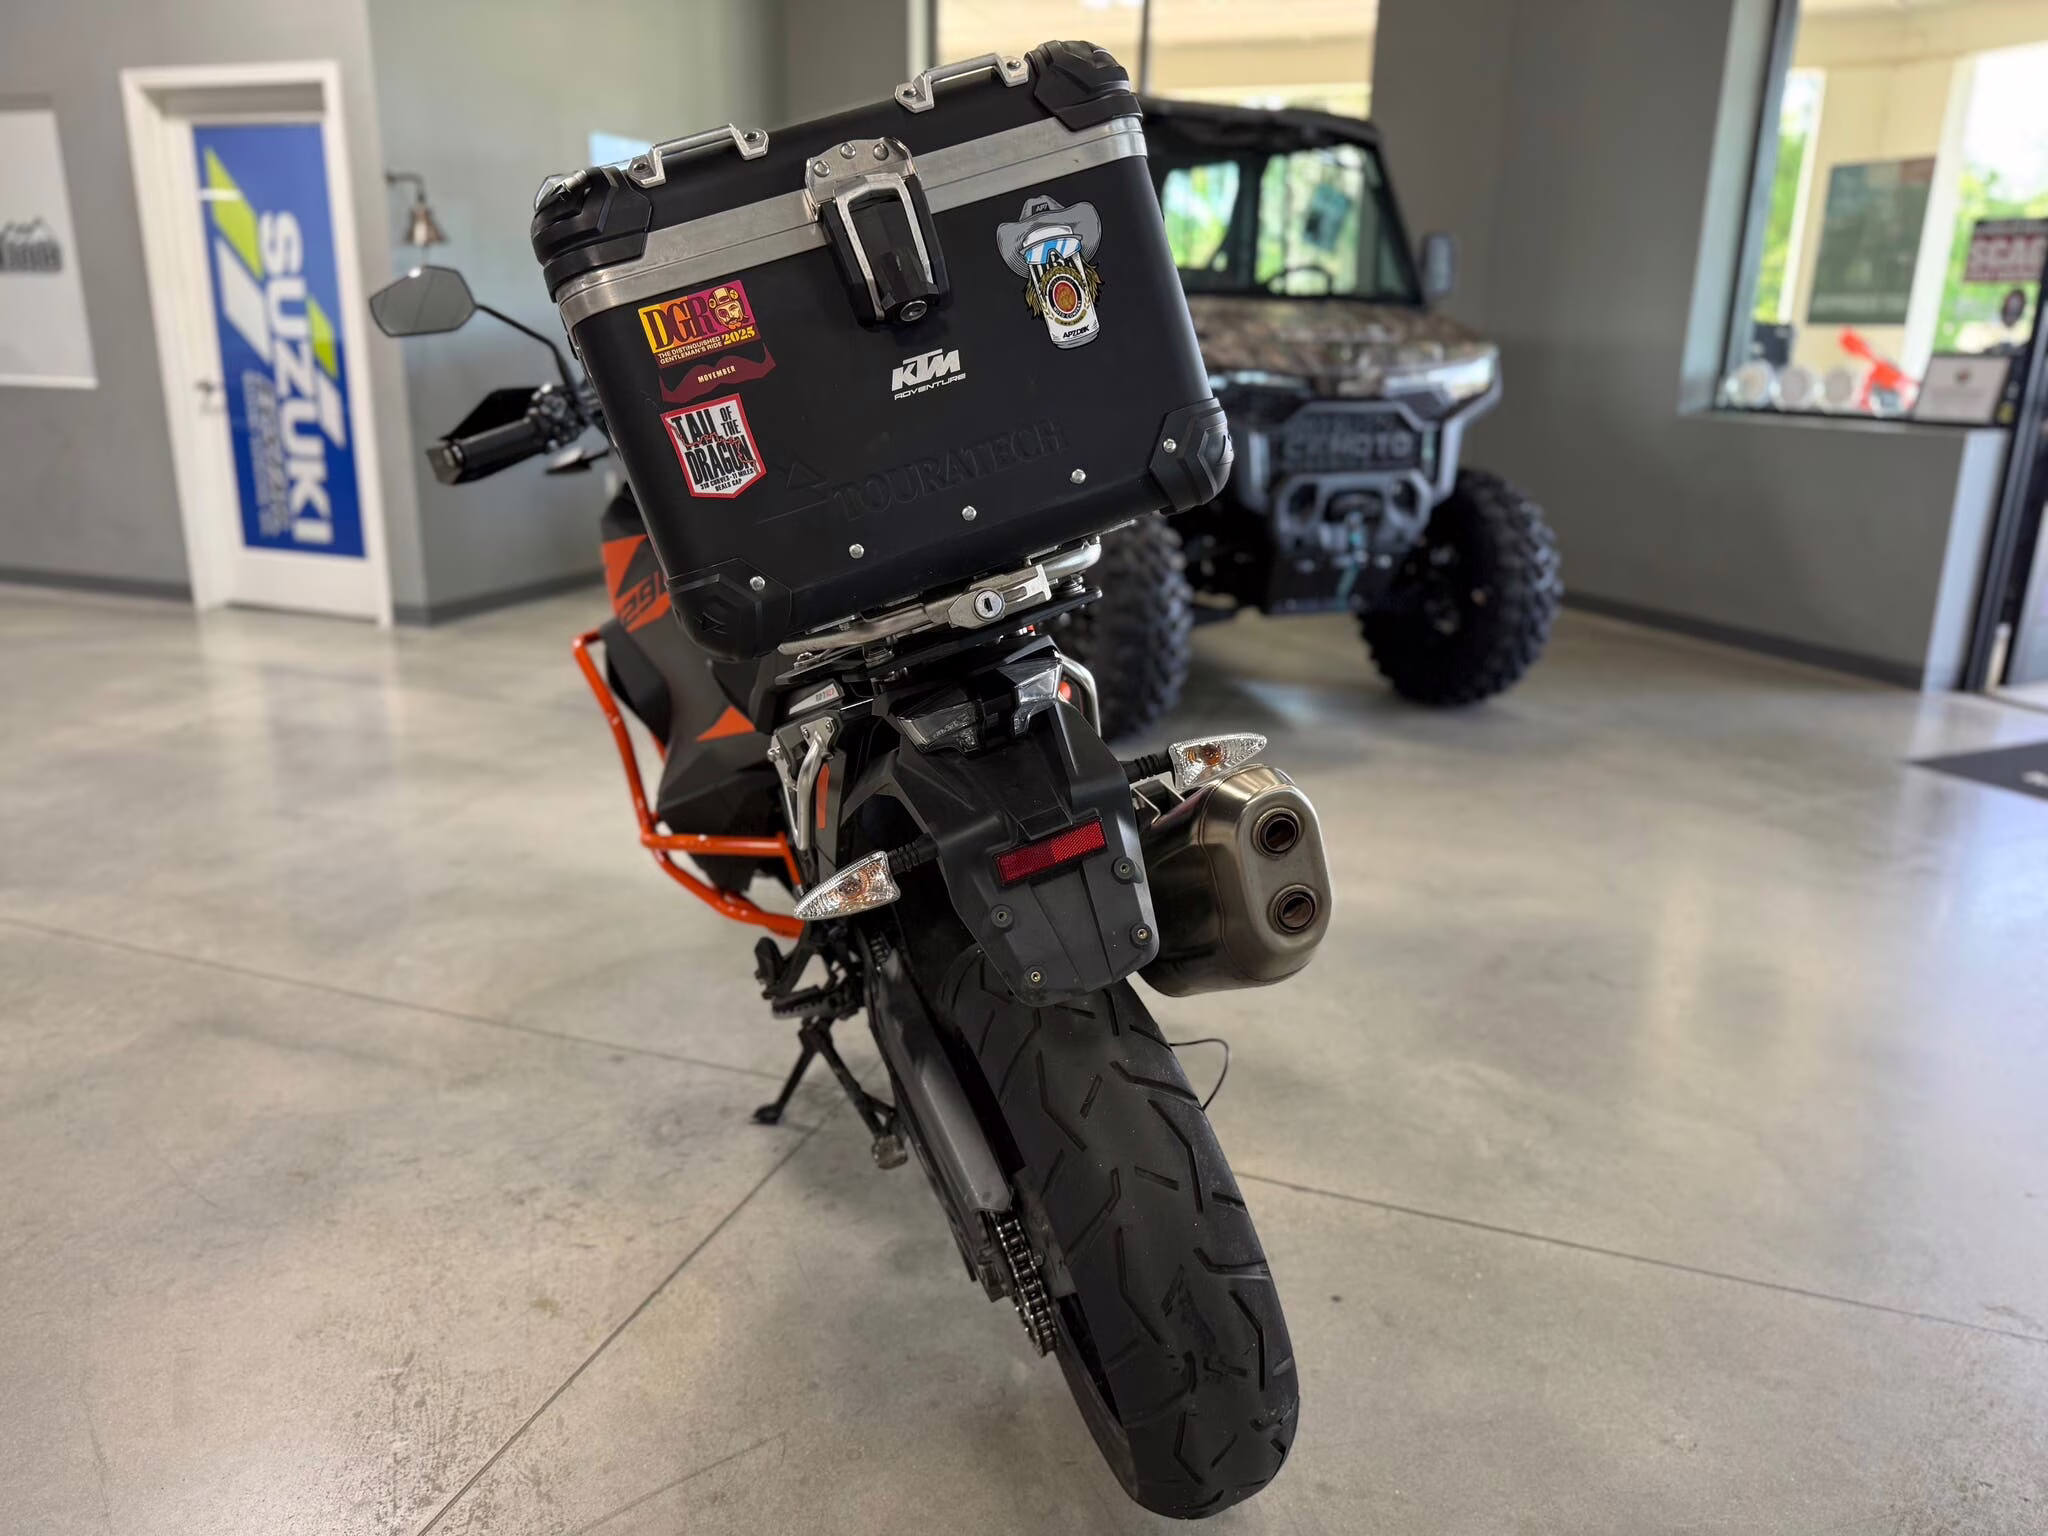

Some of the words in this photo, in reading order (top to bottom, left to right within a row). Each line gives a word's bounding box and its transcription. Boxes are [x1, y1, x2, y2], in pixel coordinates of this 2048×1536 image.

[643, 297, 718, 350] DGR
[721, 326, 755, 345] 2025
[657, 352, 671, 360] THE
[671, 336, 721, 355] DISTINGUISHED
[660, 346, 707, 364] GENTLEMAN'S
[706, 340, 723, 351] RIDE
[258, 211, 335, 545] SUZUKI
[697, 365, 736, 383] MOVEMBER
[892, 348, 961, 392] KTM
[894, 373, 966, 400] ADVENTURE
[719, 406, 733, 422] OF
[671, 408, 719, 450] TAIL
[721, 419, 740, 437] THE
[684, 434, 754, 485] DRAGON
[731, 478, 743, 486] GAP
[738, 468, 754, 477] MILES
